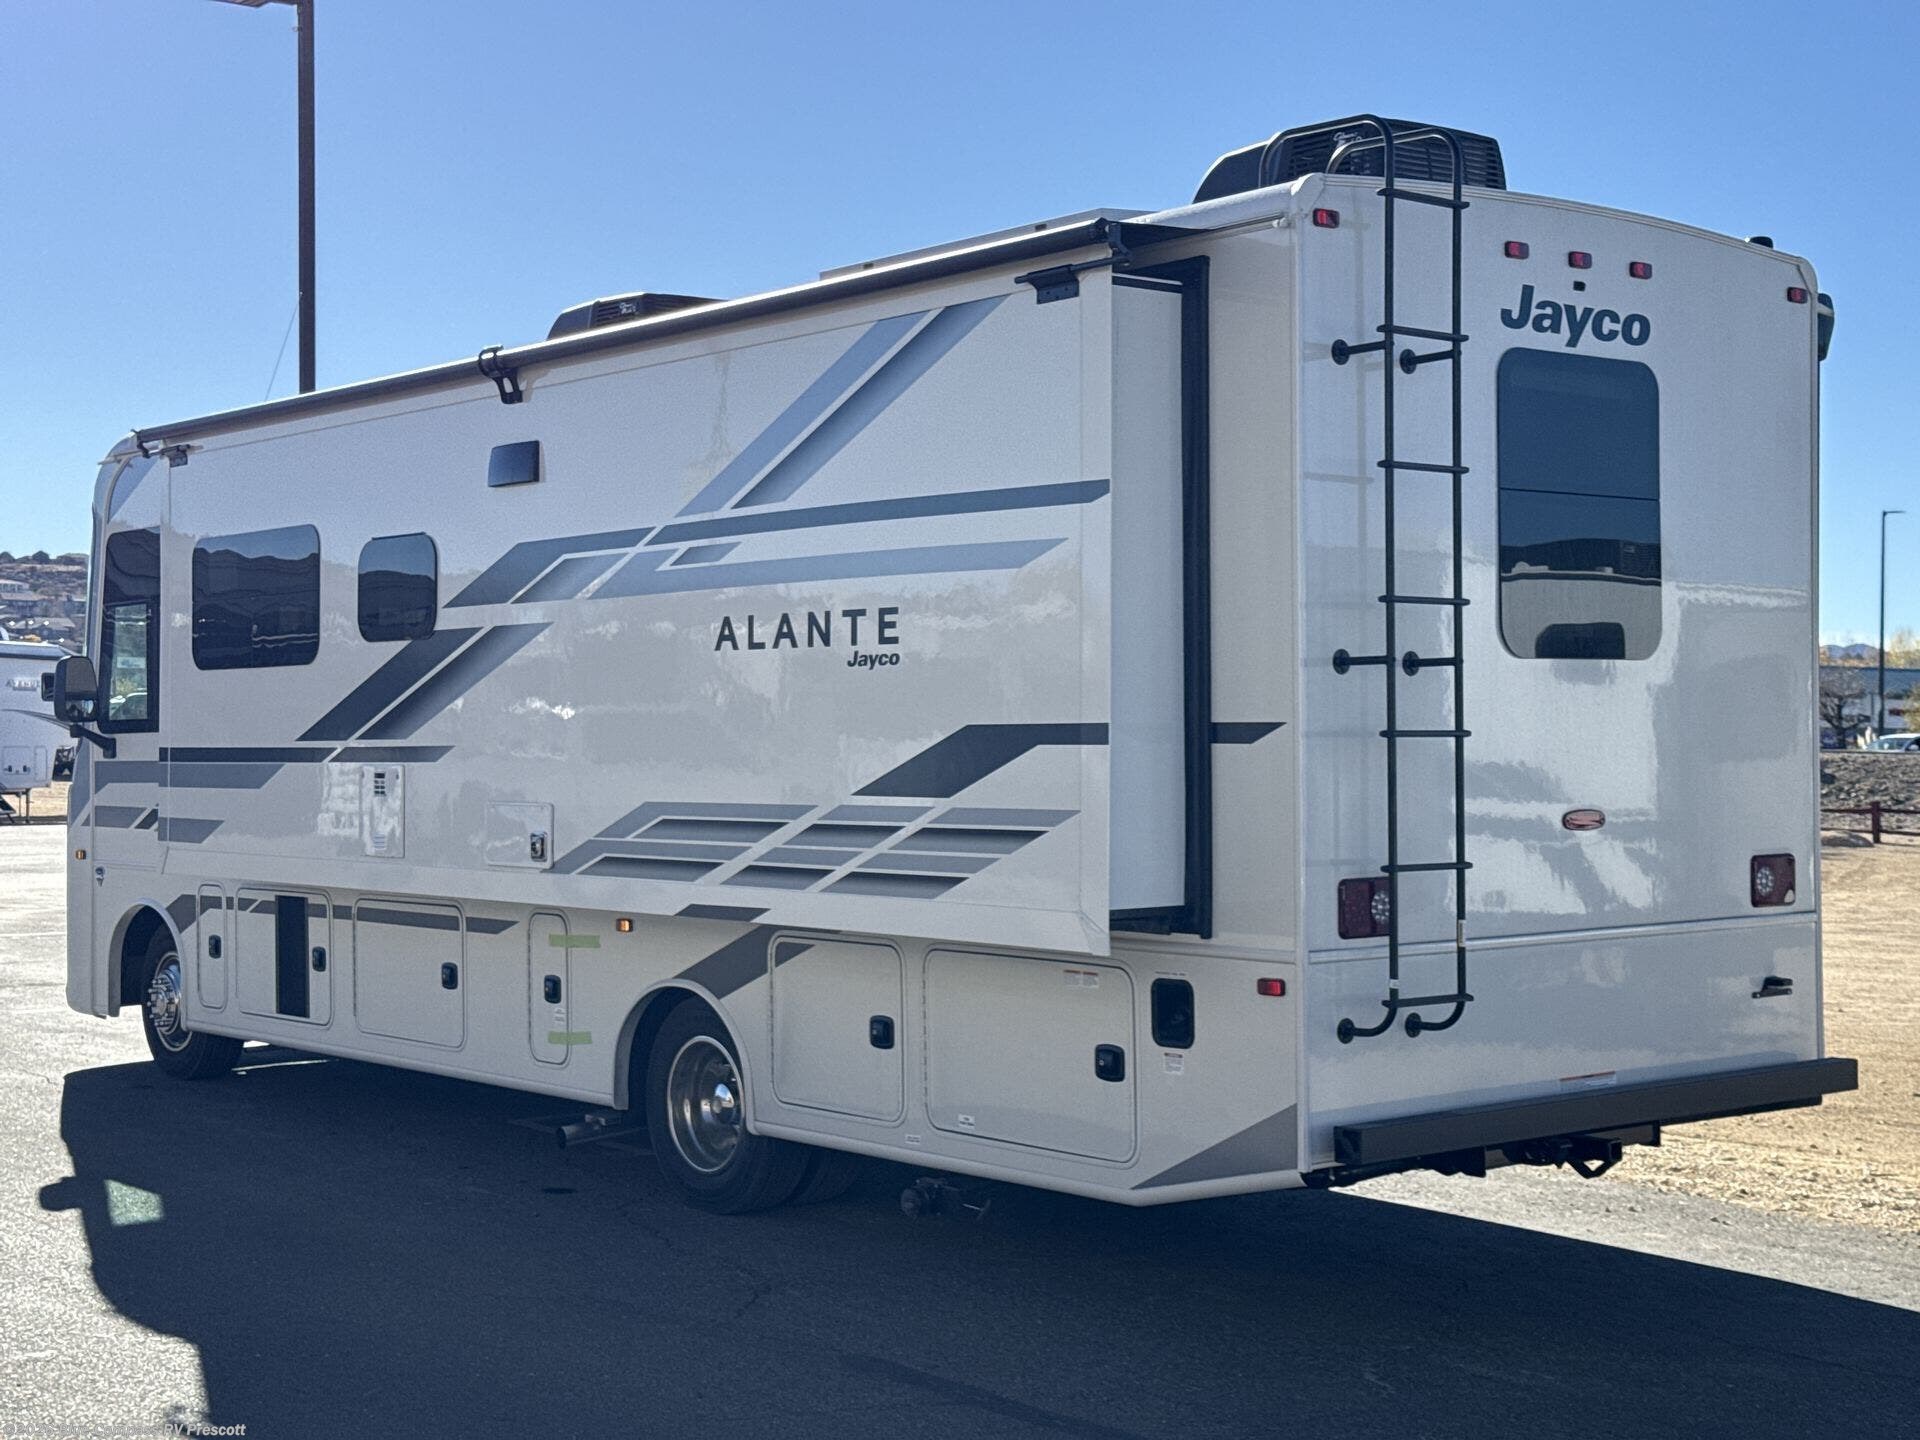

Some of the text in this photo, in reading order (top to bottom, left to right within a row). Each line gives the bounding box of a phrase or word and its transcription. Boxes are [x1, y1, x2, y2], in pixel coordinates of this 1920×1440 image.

[1500, 284, 1651, 348] Jayco
[714, 606, 900, 651] ALANTE
[847, 650, 900, 670] Jayco
